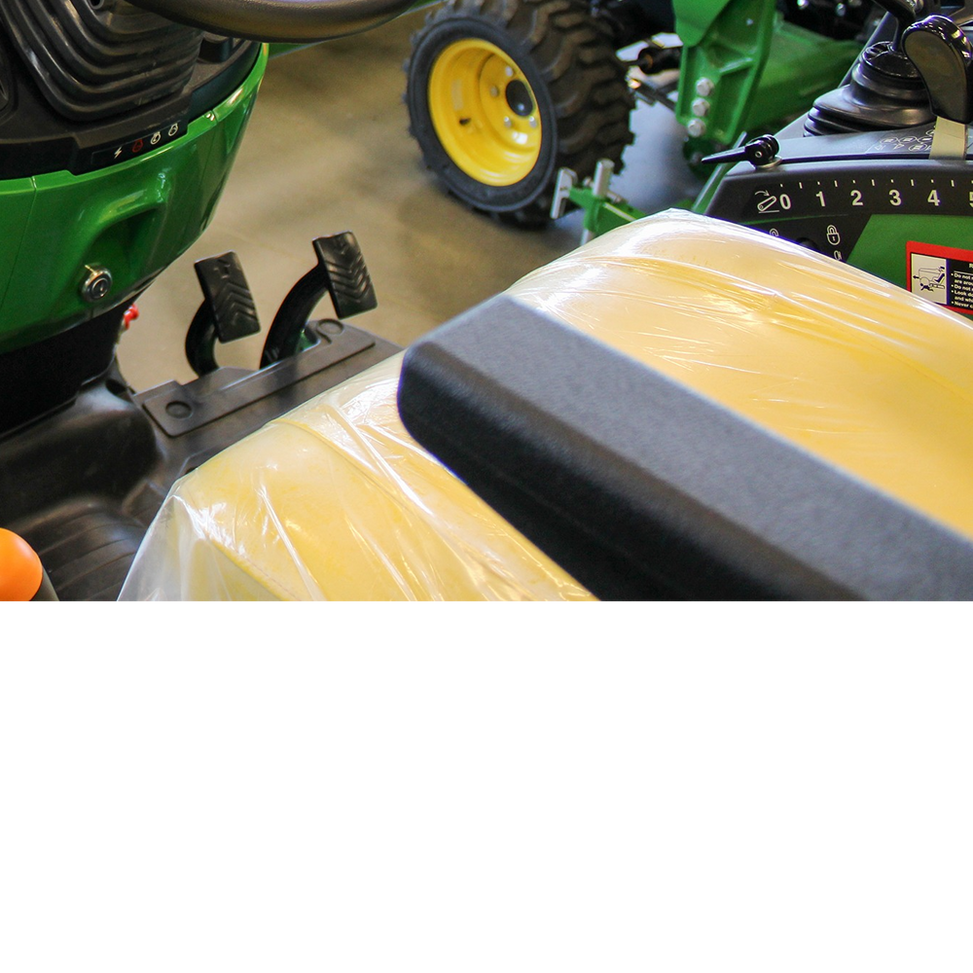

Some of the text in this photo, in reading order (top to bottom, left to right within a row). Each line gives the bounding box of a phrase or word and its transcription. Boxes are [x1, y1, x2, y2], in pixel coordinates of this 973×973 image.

[779, 189, 941, 210] 0 1 2 3 4
